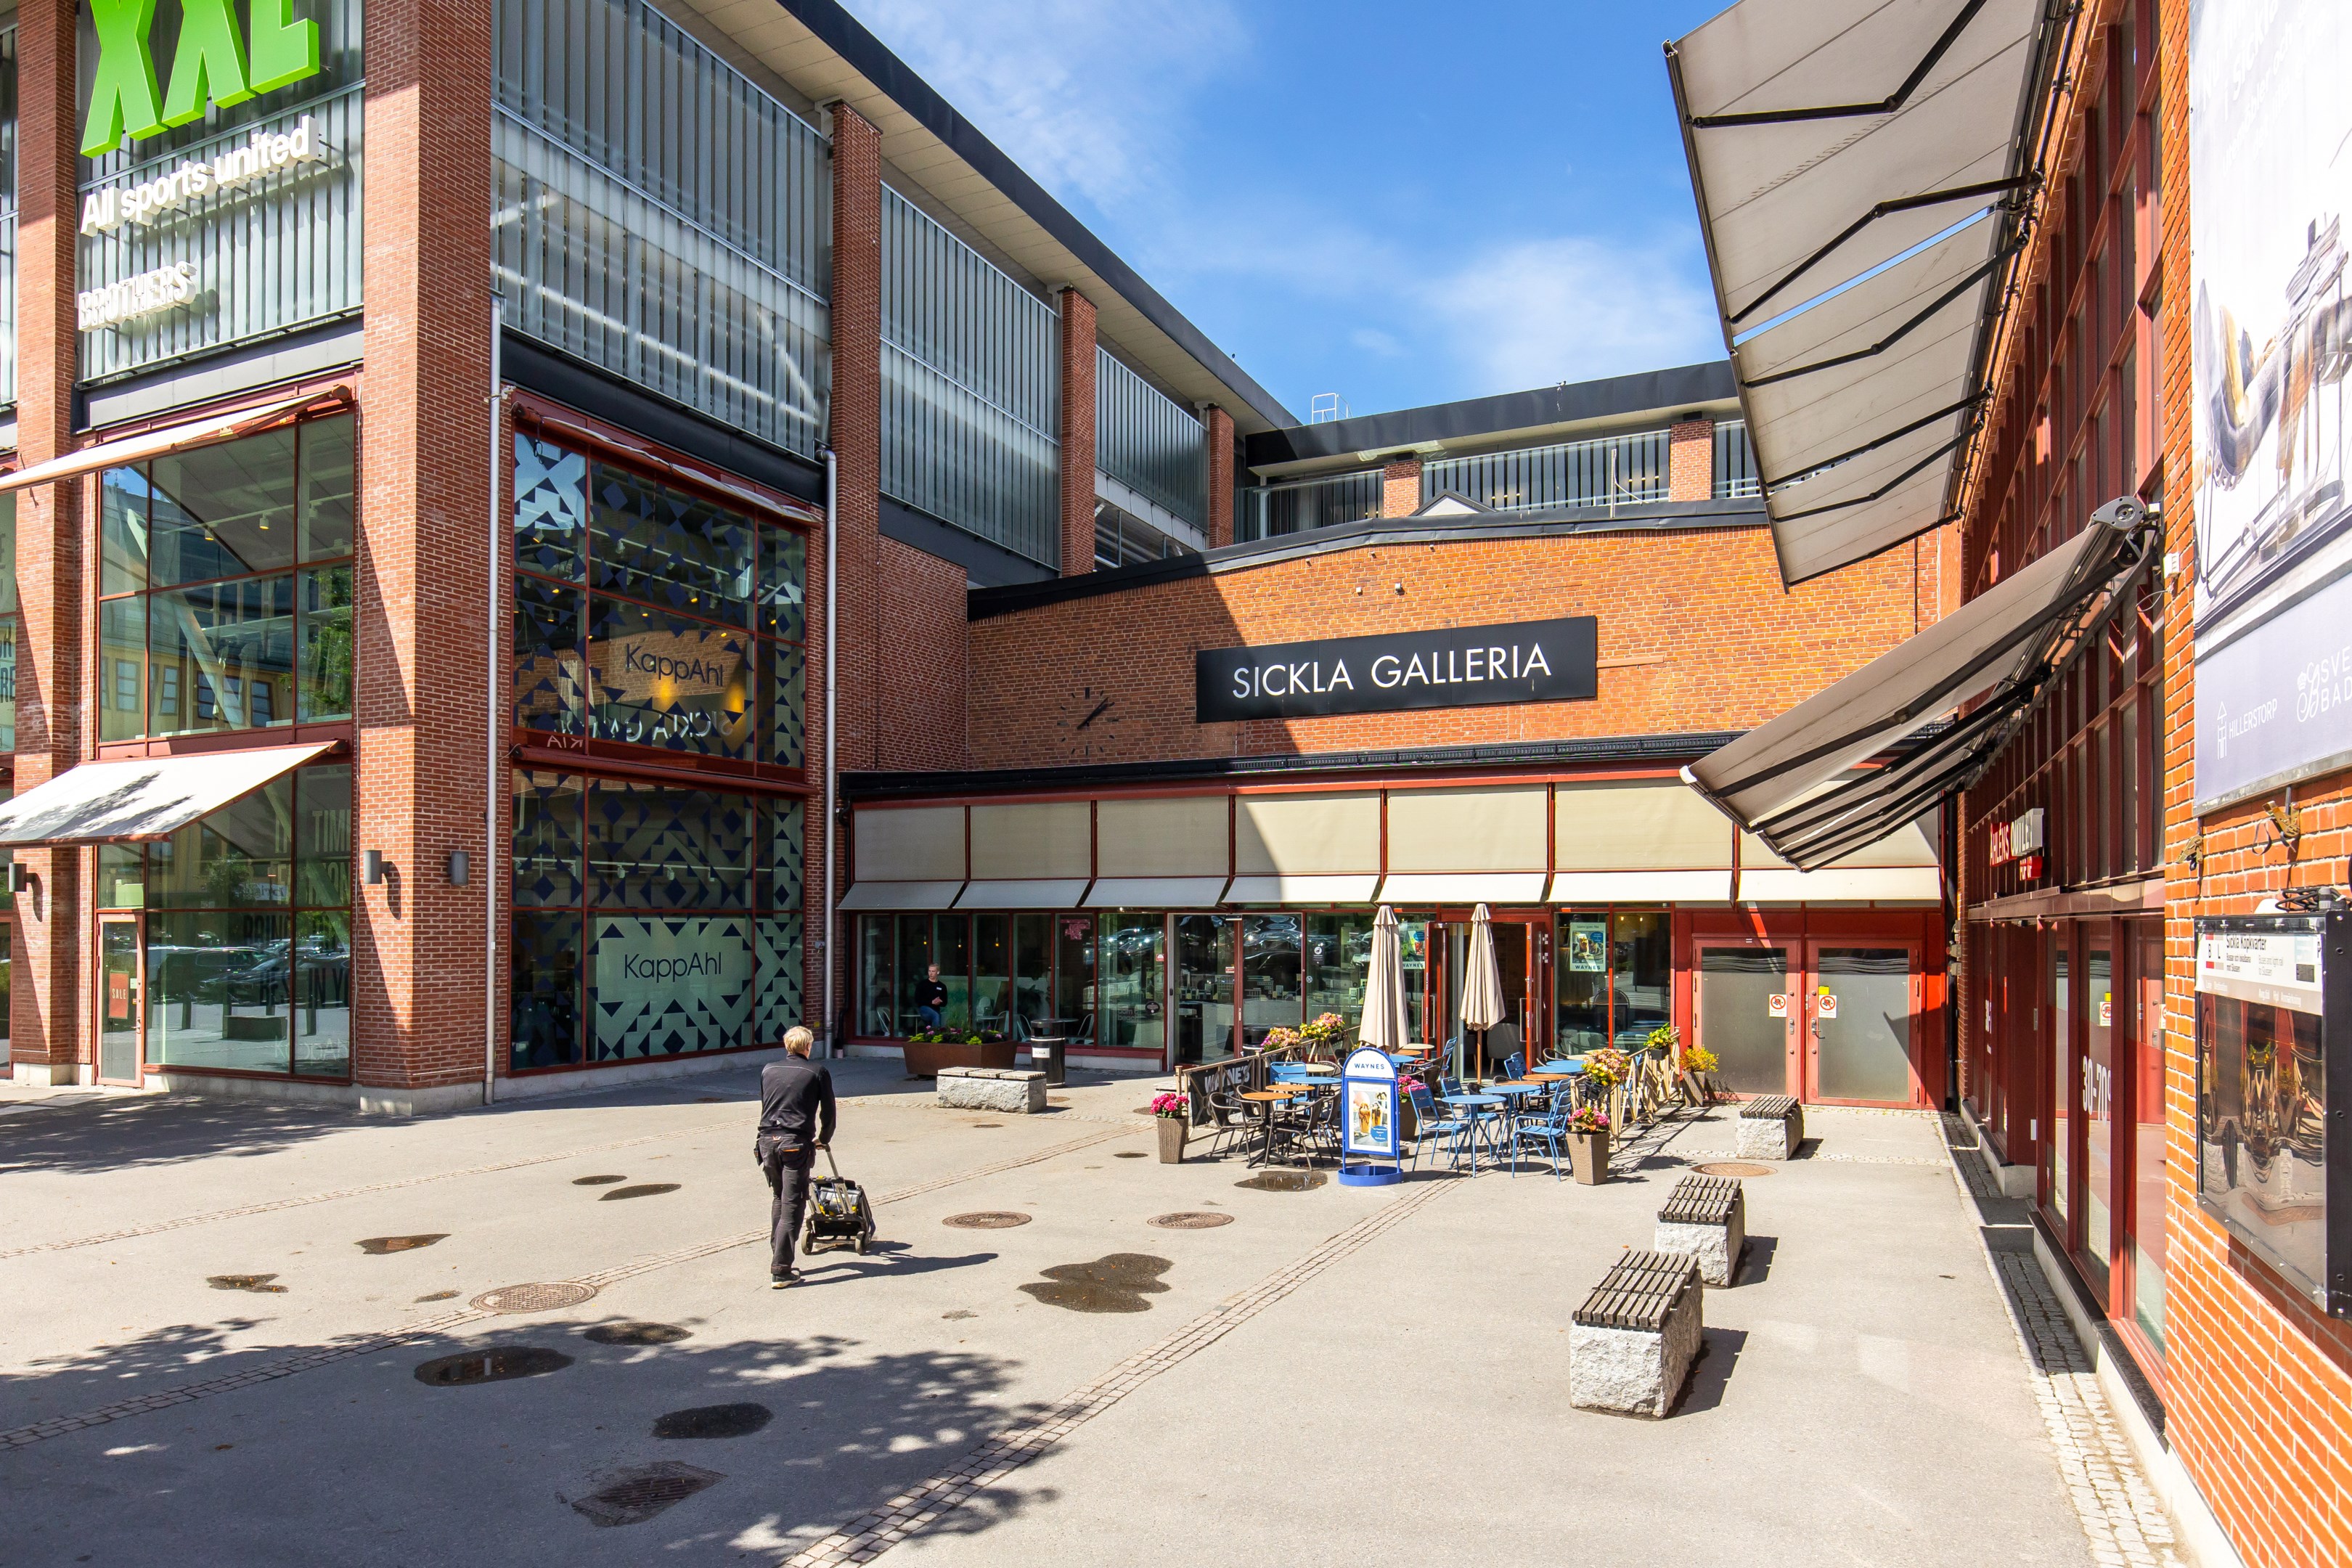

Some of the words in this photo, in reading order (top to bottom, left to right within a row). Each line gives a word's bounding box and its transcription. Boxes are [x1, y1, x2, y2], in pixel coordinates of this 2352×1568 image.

[81, 186, 120, 236] All
[121, 160, 213, 225] sports
[214, 115, 317, 187] united
[78, 261, 197, 332] BROTHERS
[626, 642, 723, 687] KappAhl
[1232, 658, 1355, 699] SICKLA
[1371, 642, 1552, 689] GALLERIA
[2229, 698, 2278, 740] HILLERSTORP
[312, 809, 351, 853] TIM
[2011, 808, 2035, 857] OUTLET
[624, 952, 722, 984] KappAhl
[112, 988, 126, 1000] SALE
[1205, 1065, 1250, 1093] WAYNE'S
